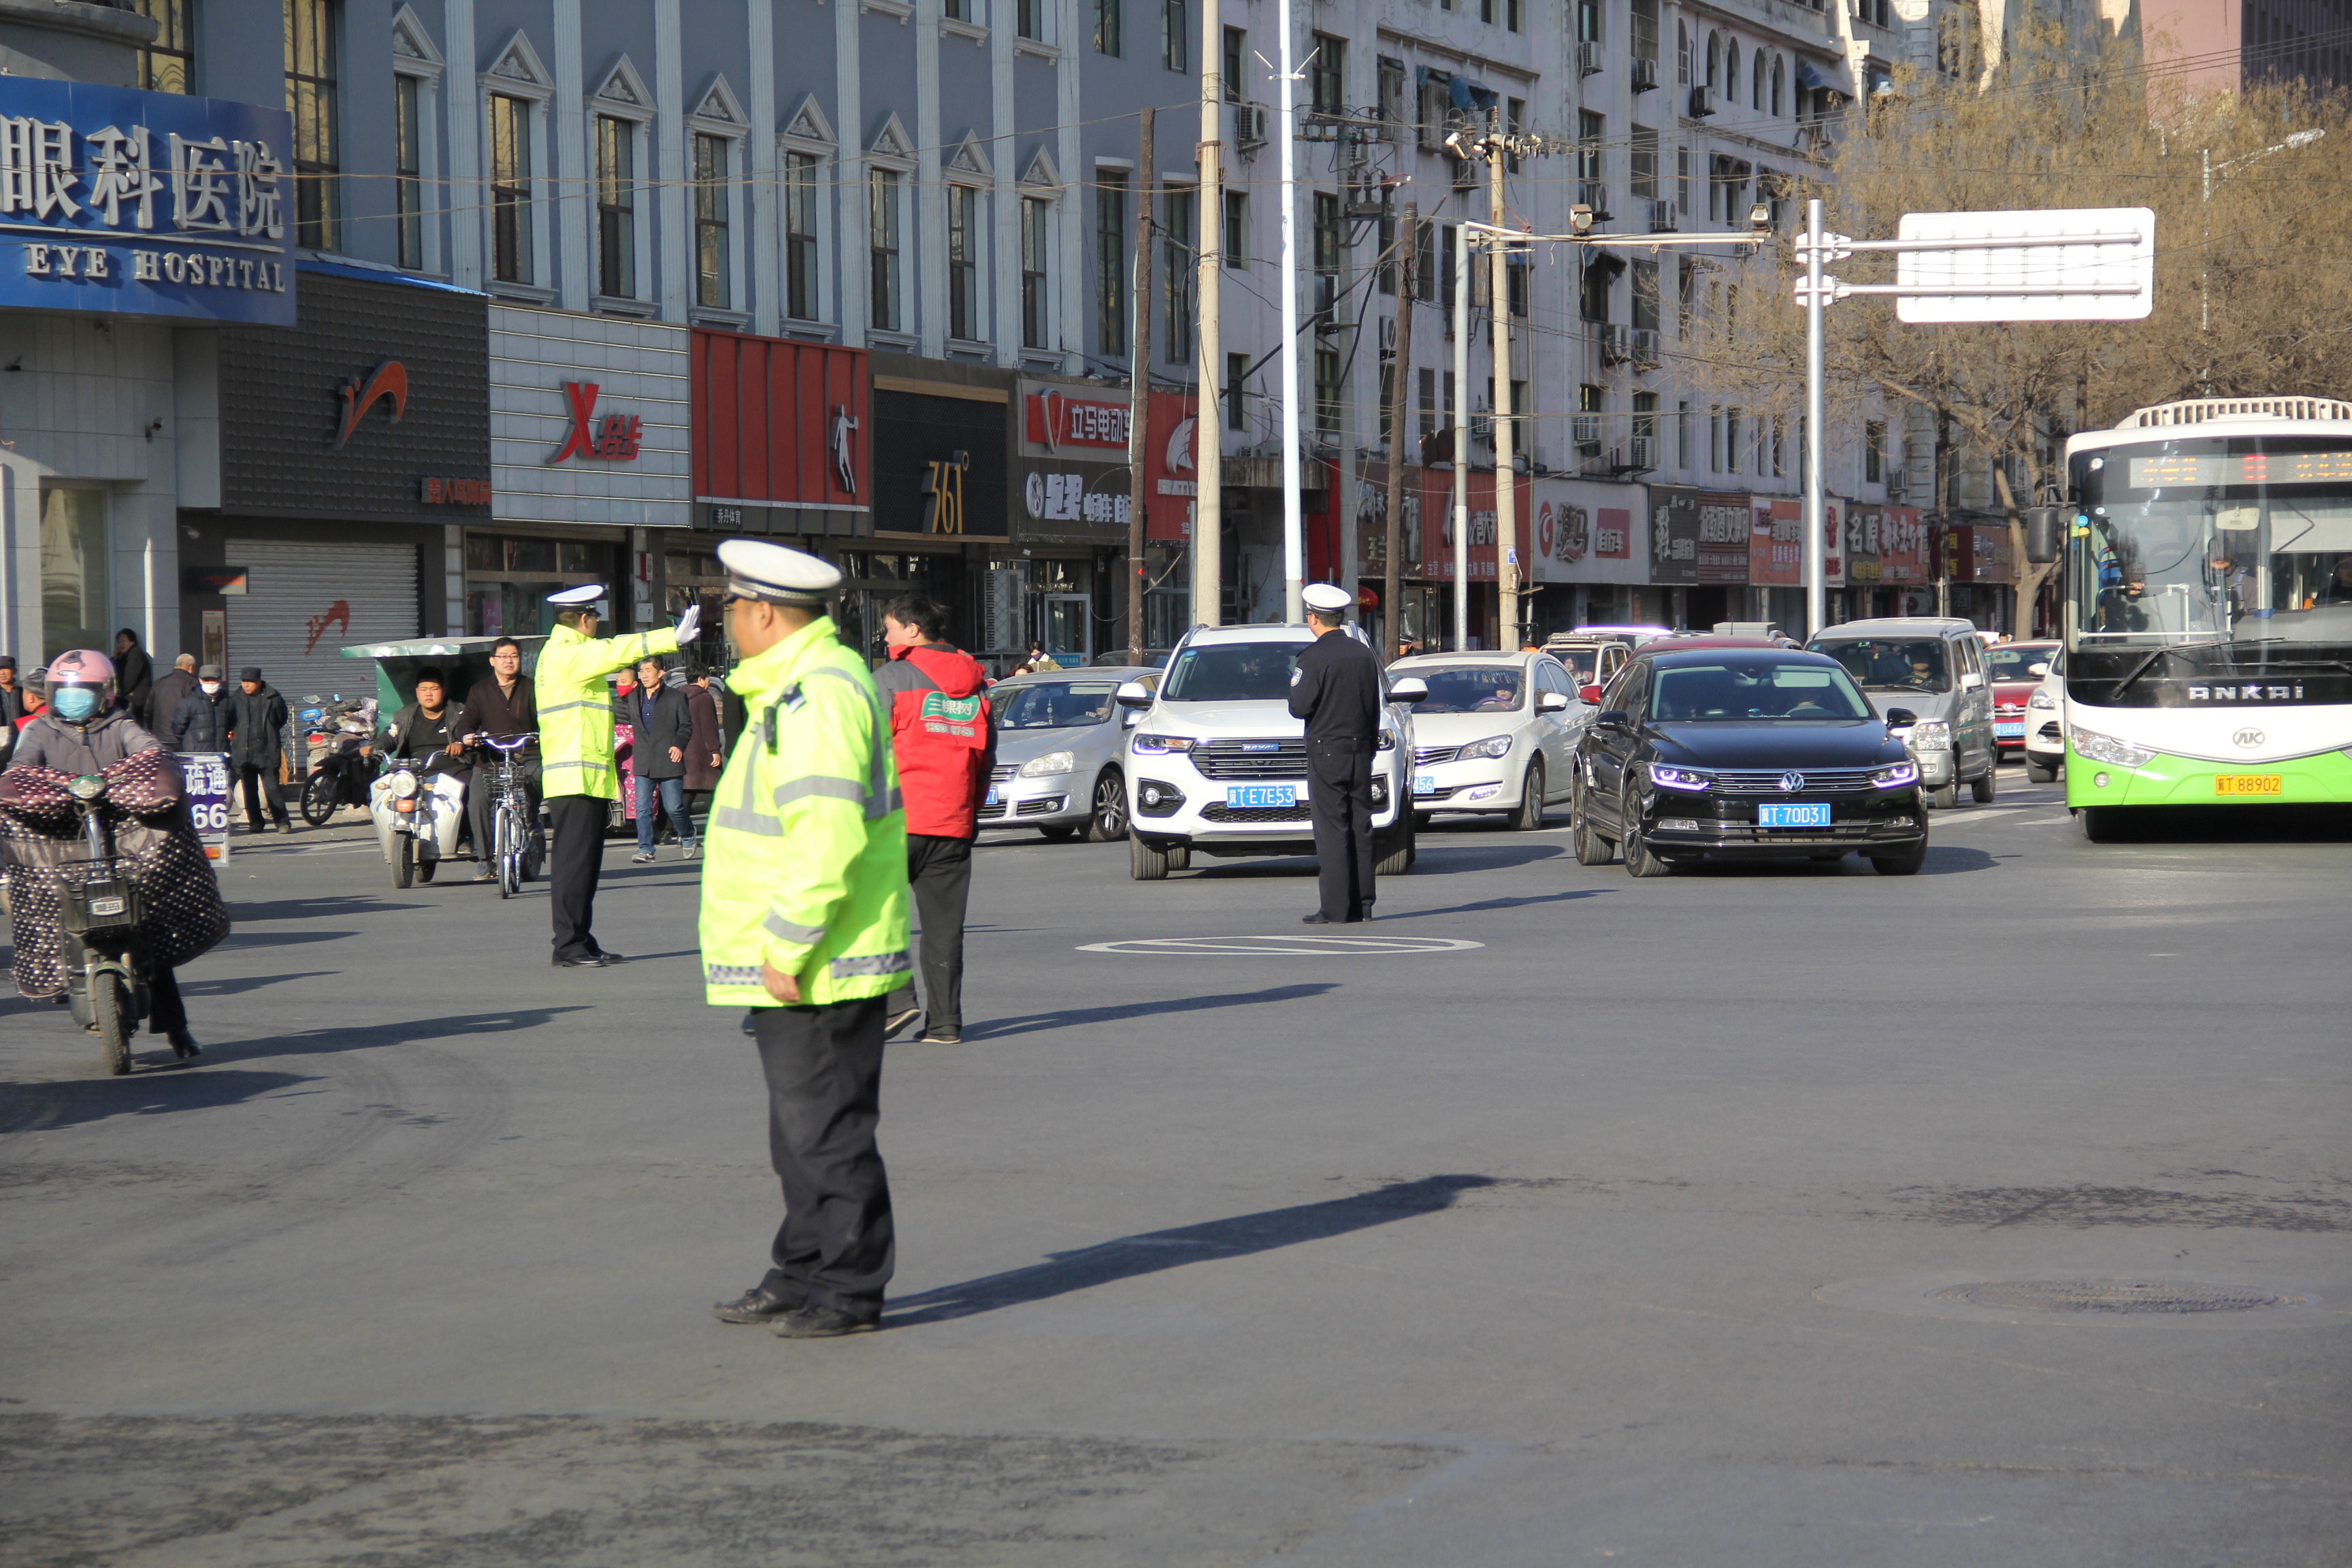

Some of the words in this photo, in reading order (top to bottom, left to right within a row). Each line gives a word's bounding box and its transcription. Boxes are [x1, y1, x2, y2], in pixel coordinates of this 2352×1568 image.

[0, 114, 284, 240] 眼科医院
[24, 243, 108, 277] EYE
[134, 249, 284, 293] HOSPITAL
[596, 414, 643, 460] 特步
[718, 508, 741, 525] 乔丹体育
[928, 698, 973, 715] 三棵树
[2189, 686, 2304, 700] ANKAI
[182, 763, 227, 795] 疏通
[191, 803, 228, 829] 66
